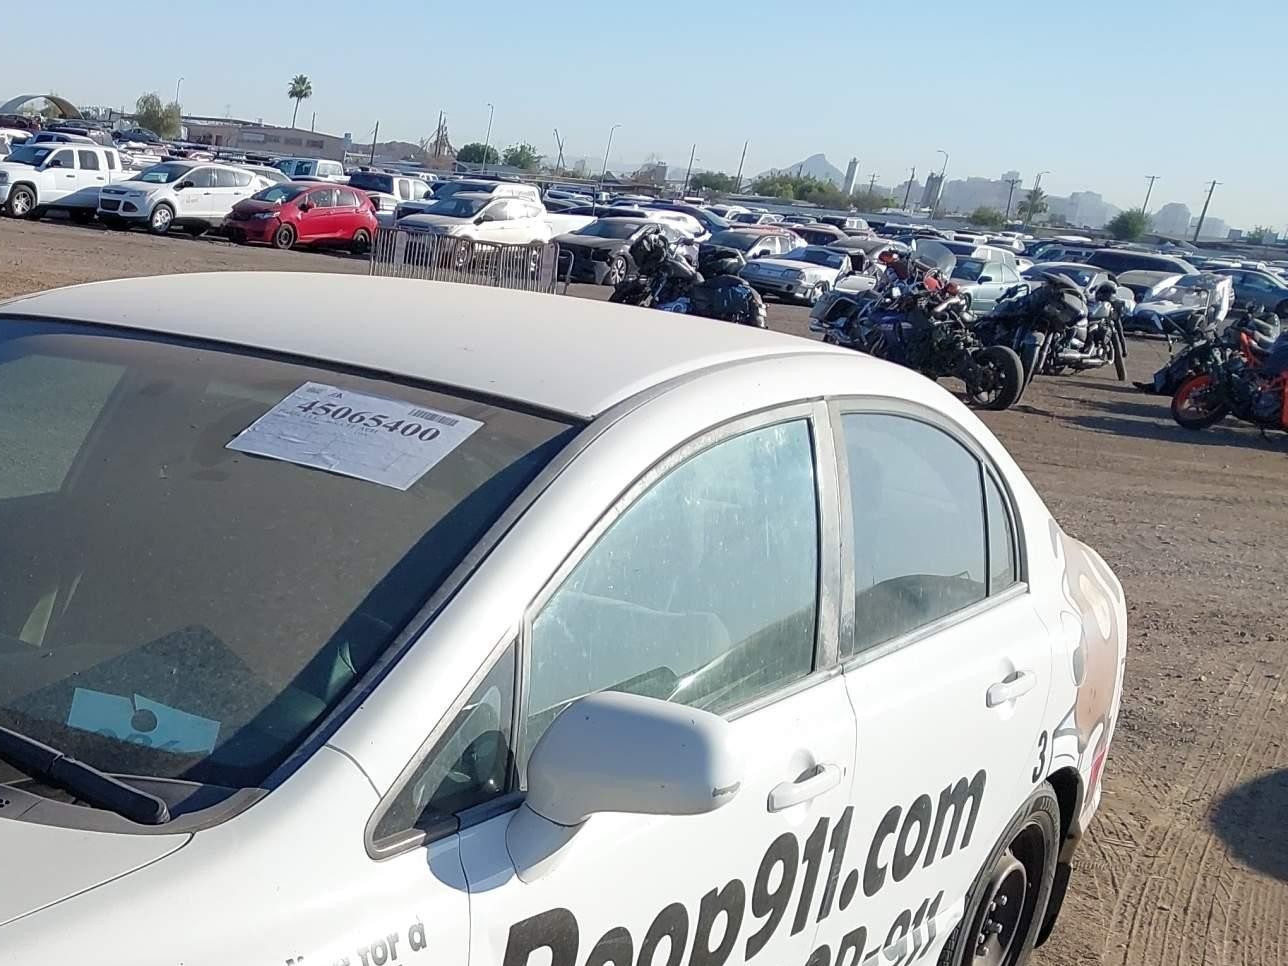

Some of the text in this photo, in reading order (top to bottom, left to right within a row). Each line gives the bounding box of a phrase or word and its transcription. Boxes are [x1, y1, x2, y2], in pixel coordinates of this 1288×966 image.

[296, 400, 441, 442] 45065400
[1032, 731, 1048, 784] 3
[408, 920, 427, 952] a
